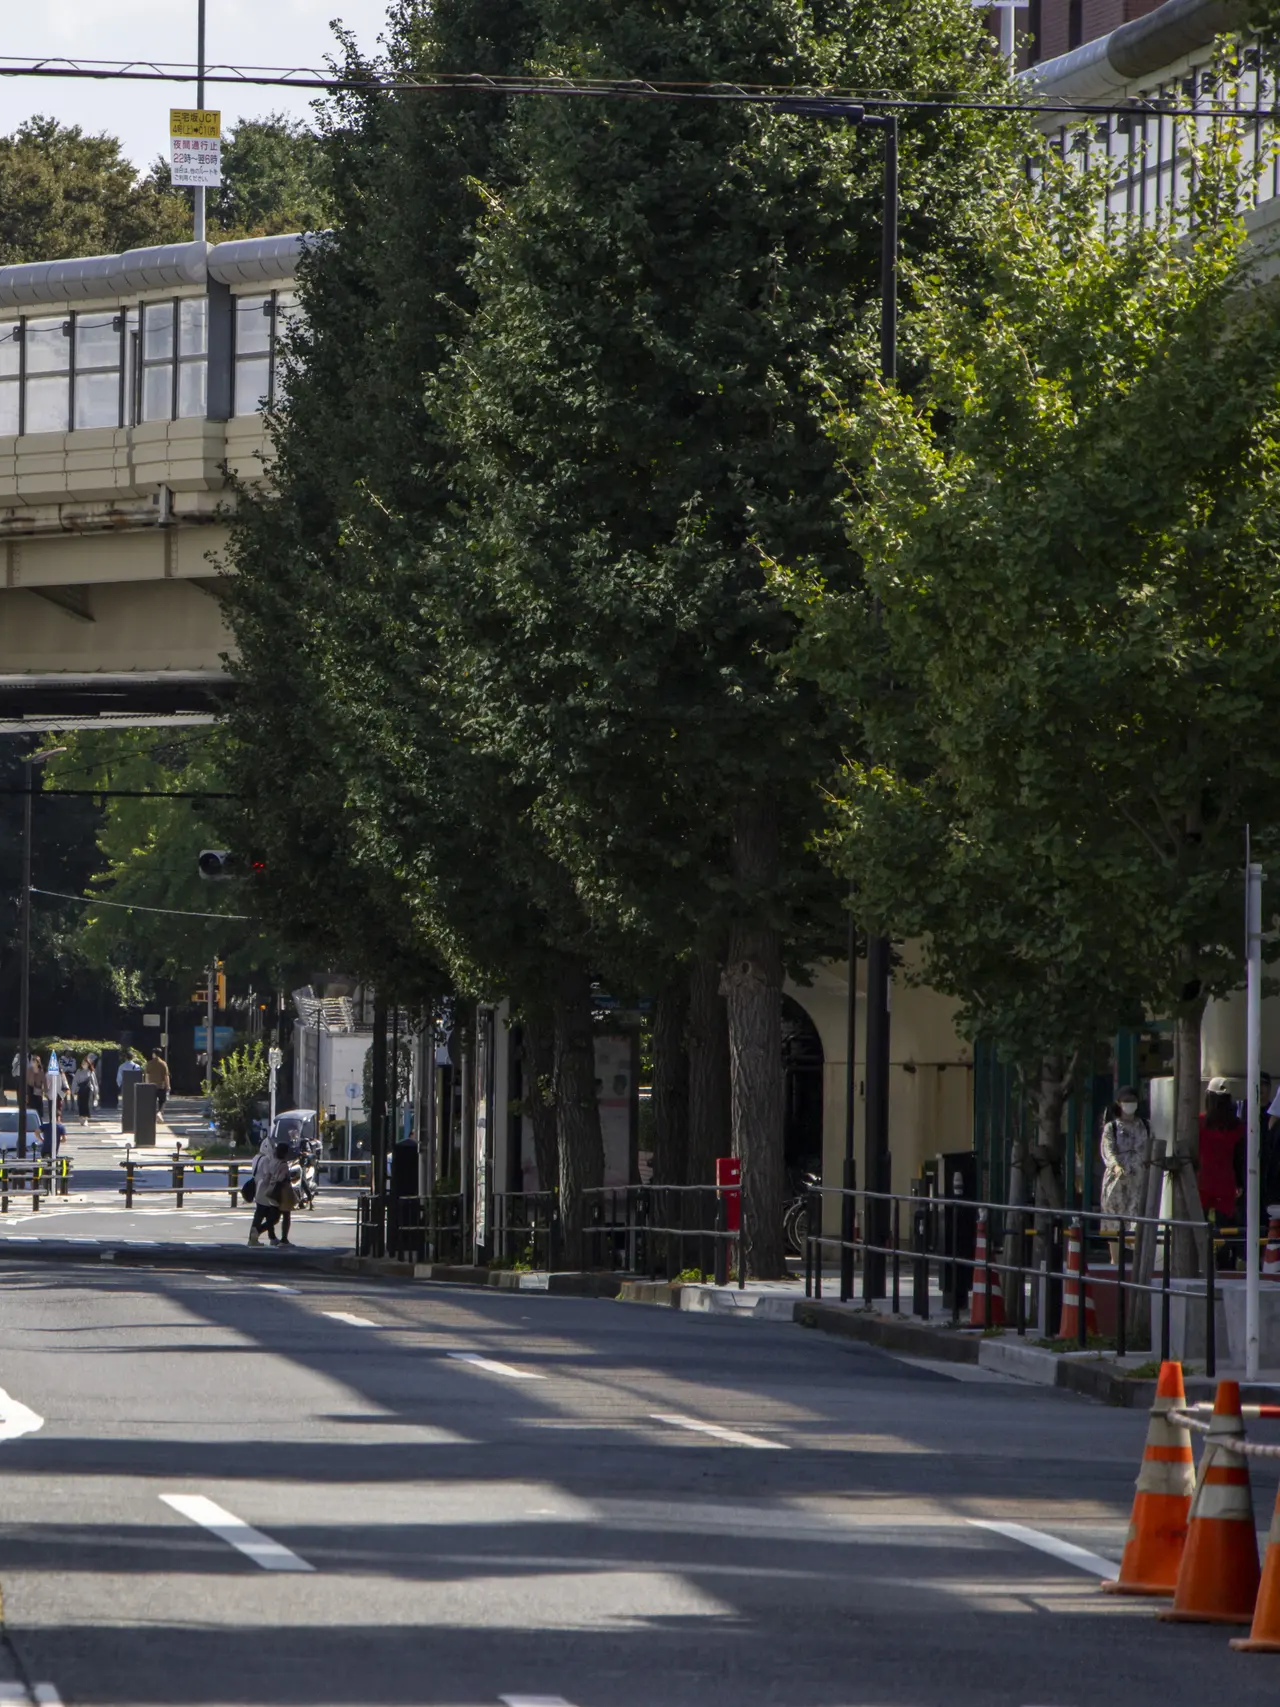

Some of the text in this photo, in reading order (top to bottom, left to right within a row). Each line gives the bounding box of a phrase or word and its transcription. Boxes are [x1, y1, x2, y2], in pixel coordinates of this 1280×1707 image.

[173, 112, 218, 122] 三宅坂JCT
[174, 140, 218, 150] 夜間通行止
